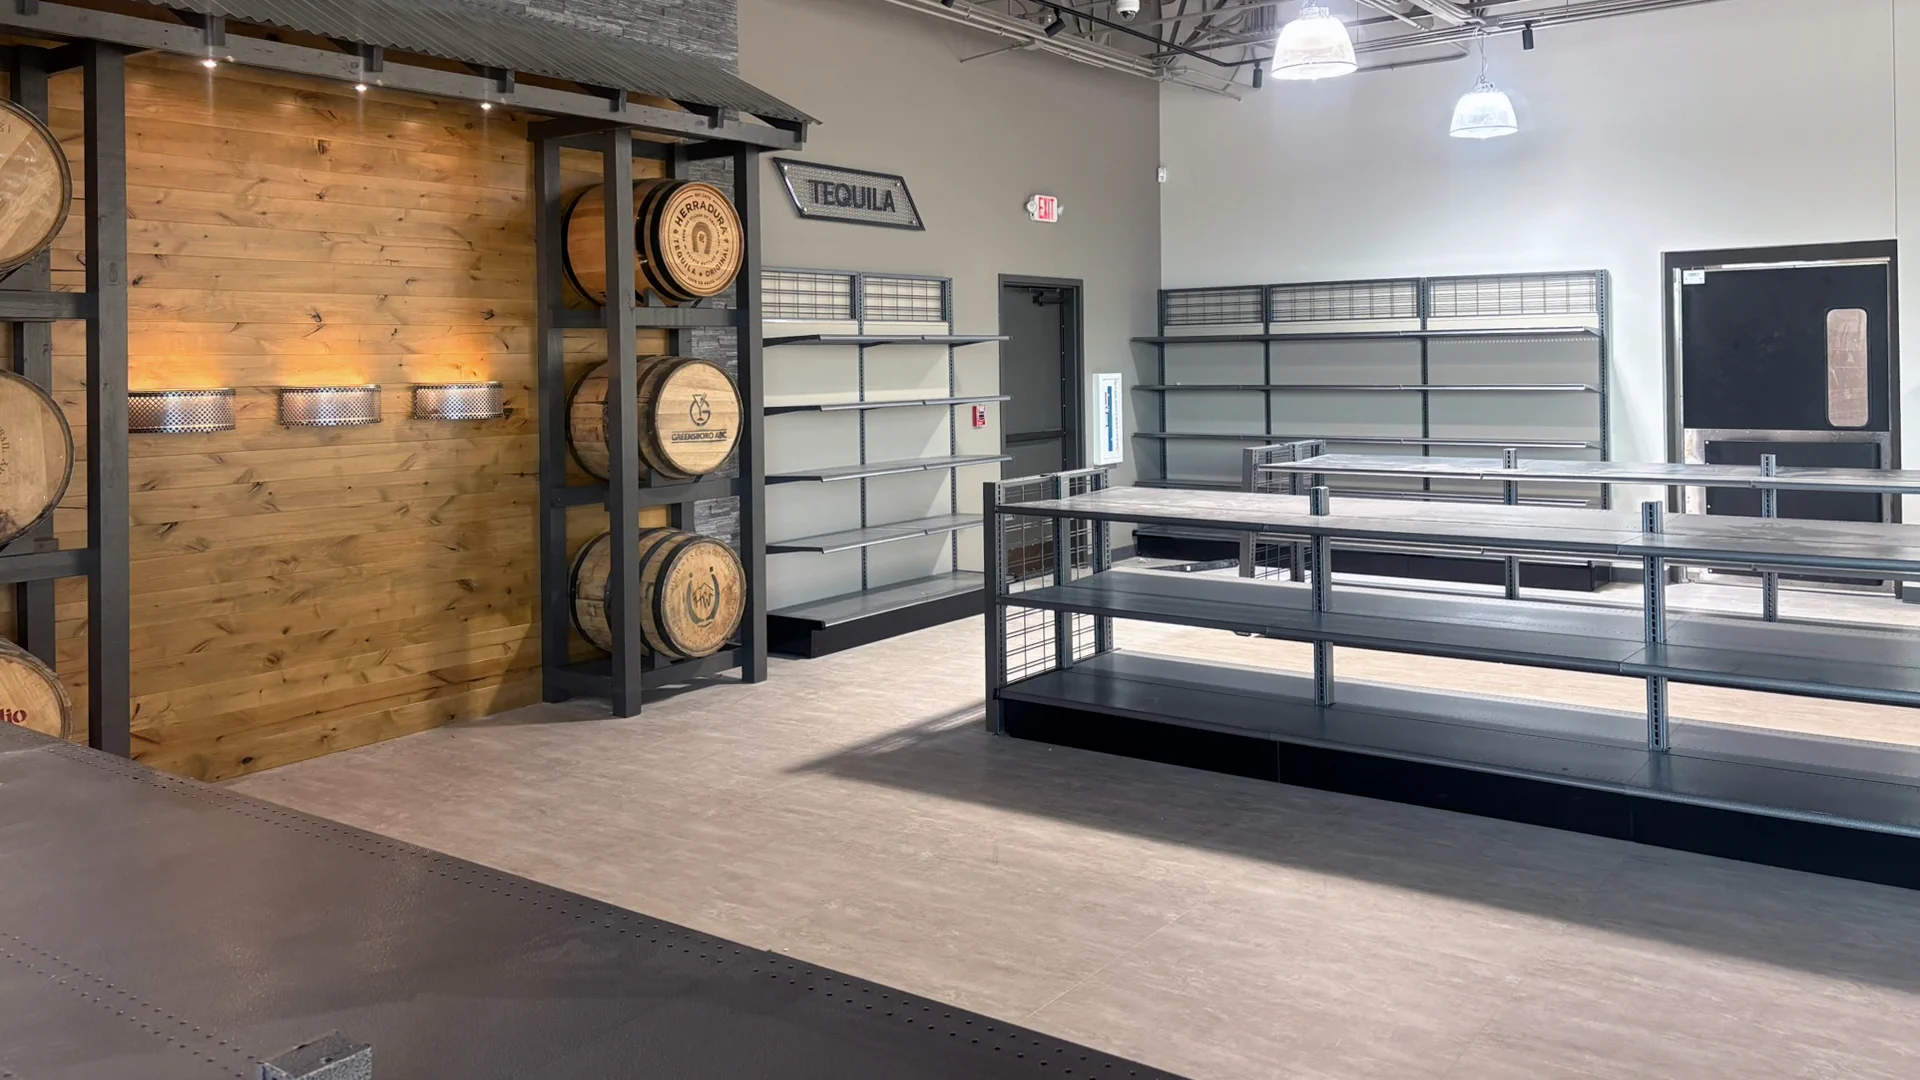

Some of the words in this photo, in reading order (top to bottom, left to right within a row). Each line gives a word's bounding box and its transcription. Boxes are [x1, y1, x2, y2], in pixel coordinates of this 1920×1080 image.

[807, 179, 896, 213] TEQUILA
[1038, 196, 1055, 220] EXIT
[674, 200, 729, 235] HERRADURA
[673, 239, 697, 276] TEQUILA
[704, 247, 729, 278] ORIGINAL
[671, 432, 714, 441] GREENSBORO
[714, 431, 727, 439] ABC
